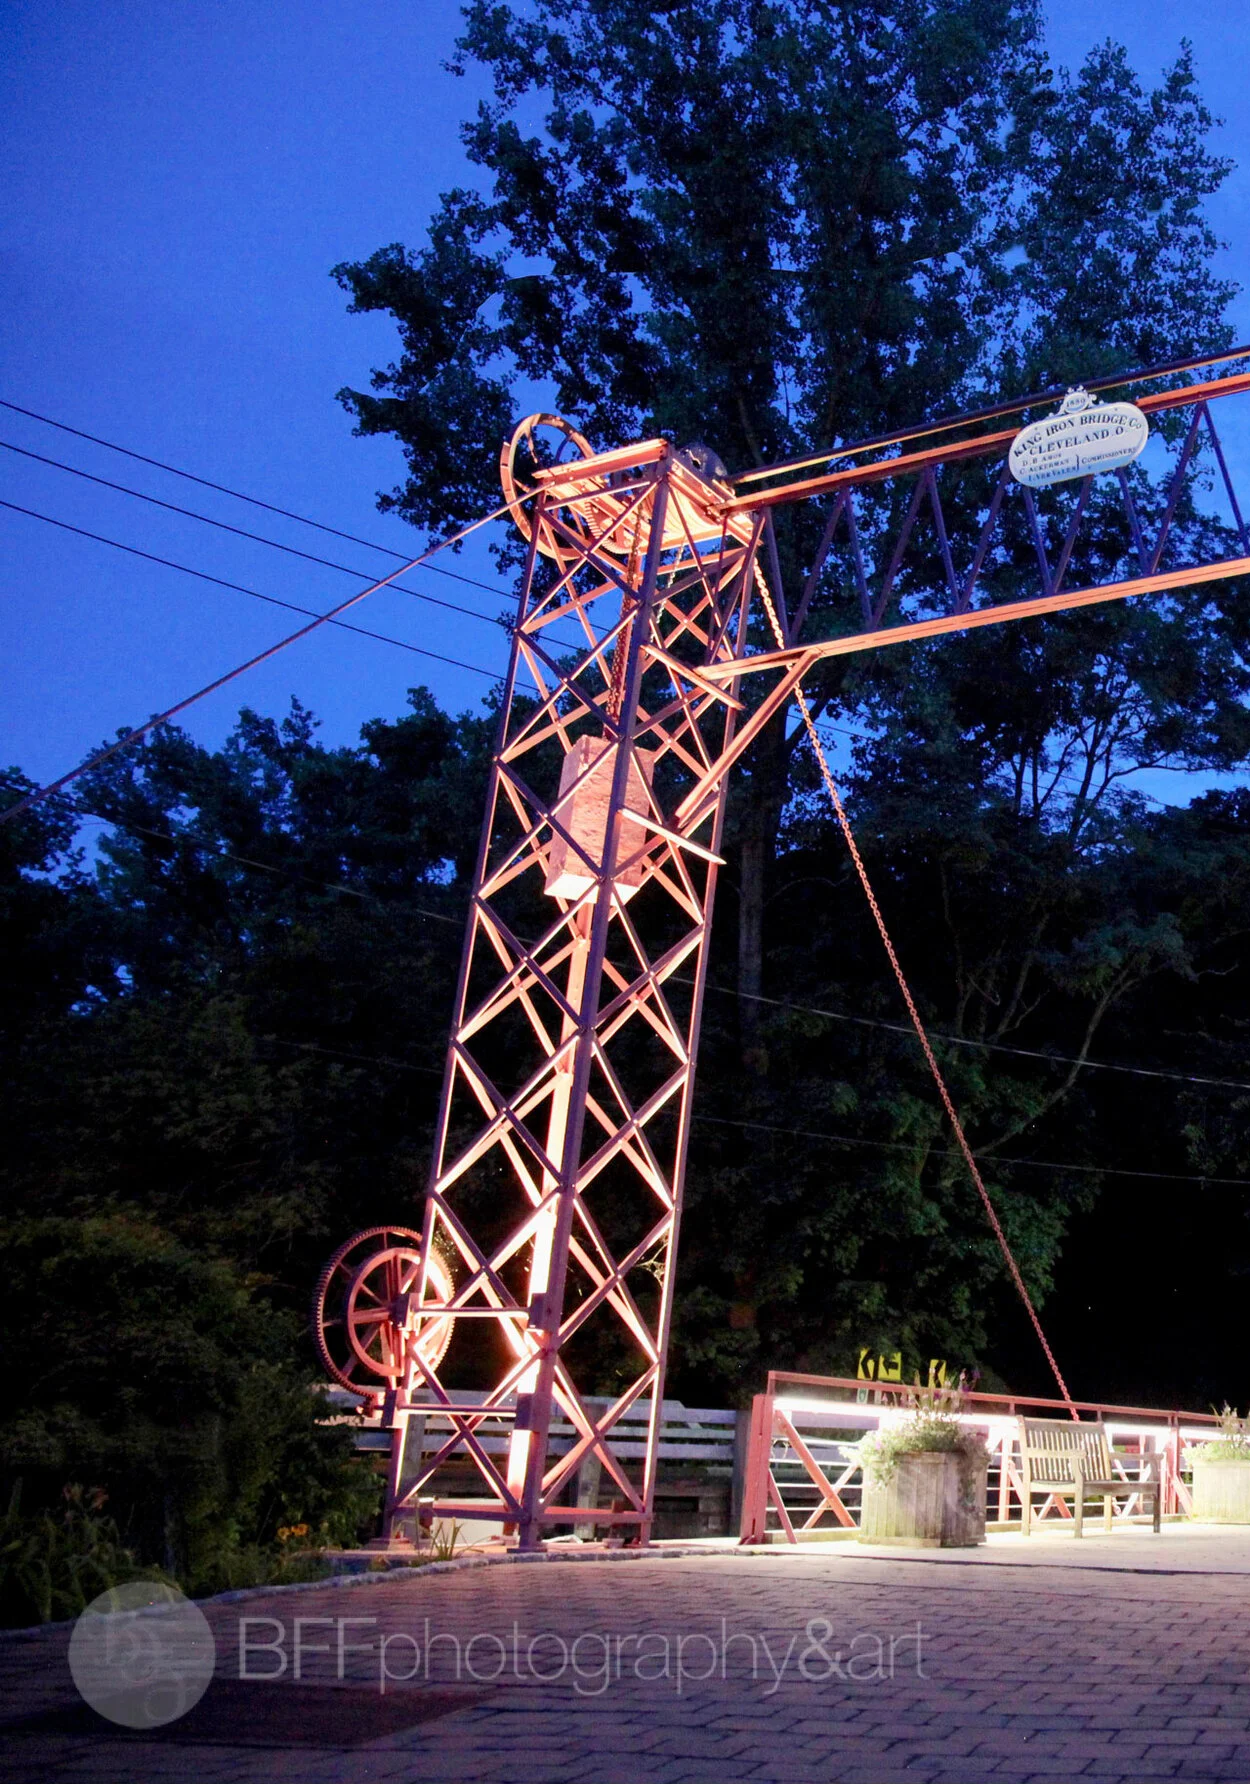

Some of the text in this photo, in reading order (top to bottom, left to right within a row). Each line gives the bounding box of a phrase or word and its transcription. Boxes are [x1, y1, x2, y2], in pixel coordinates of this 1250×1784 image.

[1014, 432, 1042, 457] KING
[1046, 419, 1074, 436] IRON
[1080, 415, 1127, 425] BRIDGE
[1029, 428, 1109, 455] CLEVELAND
[1029, 458, 1069, 473] ACKERMAN
